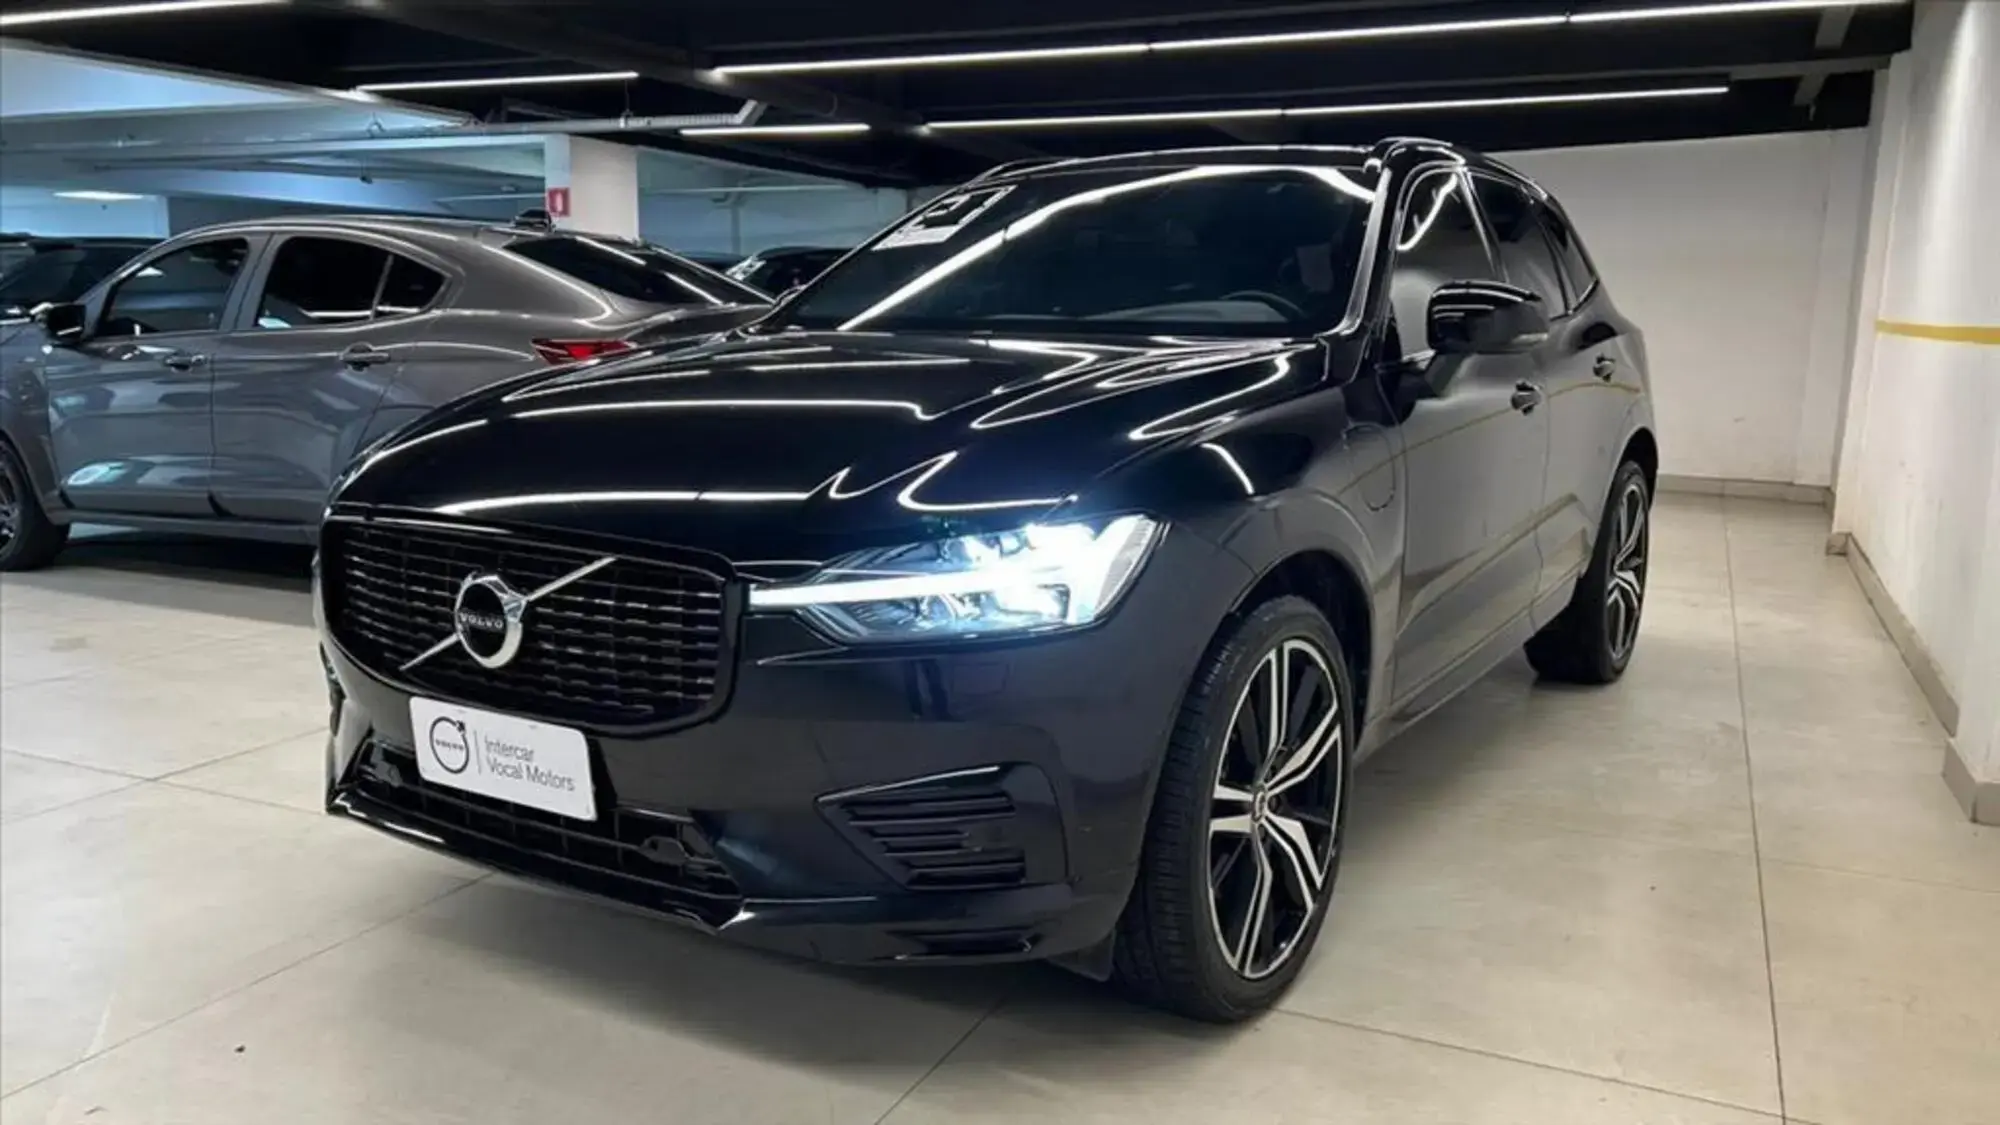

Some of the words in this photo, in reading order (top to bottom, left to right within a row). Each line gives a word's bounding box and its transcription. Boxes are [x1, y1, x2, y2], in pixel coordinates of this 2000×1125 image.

[460, 611, 504, 629] VOLVO
[485, 734, 535, 762] Intercar
[487, 755, 524, 780] Vocal
[526, 765, 576, 791] Motors
